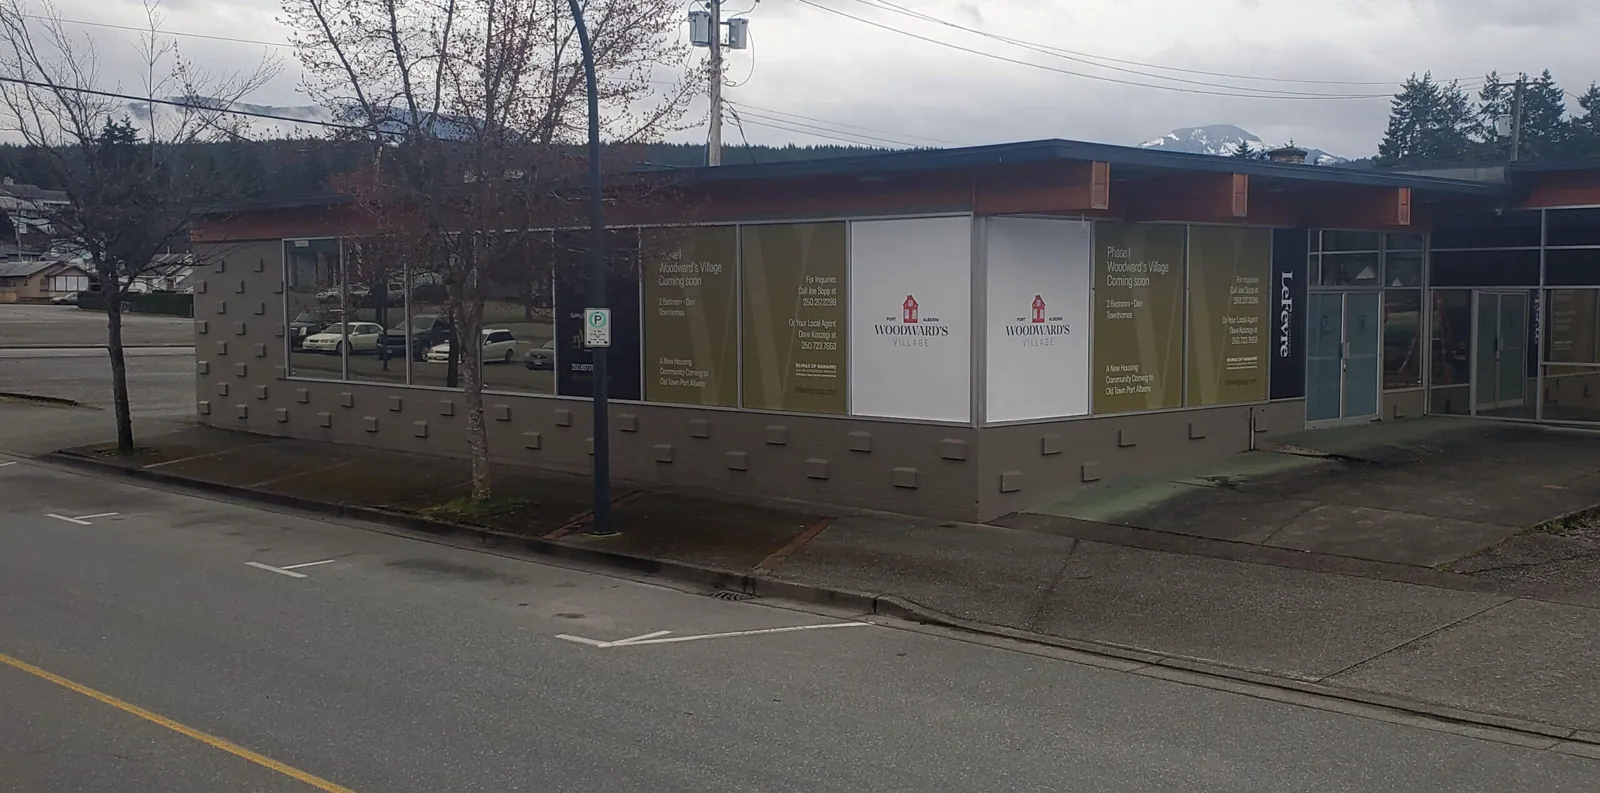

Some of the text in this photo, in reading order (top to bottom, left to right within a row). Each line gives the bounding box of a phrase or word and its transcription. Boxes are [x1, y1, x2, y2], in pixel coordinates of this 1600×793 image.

[1107, 246, 1128, 259] Phase
[658, 261, 722, 275] Woodward's Village
[1107, 260, 1169, 275] Woodward's Village
[658, 275, 702, 288] Coming soon
[806, 276, 837, 285] For Inquiries
[1107, 274, 1150, 288] Coming soon
[798, 286, 808, 295] Call
[808, 287, 817, 295] Joe
[817, 287, 830, 296] Sopp
[1106, 300, 1110, 308] 2
[1110, 300, 1130, 308] Bedroom
[594, 315, 602, 324] P
[1106, 311, 1133, 319] Townhomes
[1280, 271, 1293, 358] LeFevre
[788, 318, 837, 329] Or Your Local Agent
[798, 330, 811, 338] Dave
[874, 325, 949, 337] WOODWARD'S
[1006, 325, 1070, 336] WOODWARD'S
[893, 338, 929, 348] VILLAGE
[1022, 338, 1054, 347] VILLAGE
[664, 357, 673, 365] New
[674, 358, 692, 367] Housing
[660, 368, 685, 376] Community
[685, 368, 702, 378] Coming
[1121, 364, 1138, 372] Housing
[668, 378, 680, 386] Town
[680, 379, 690, 387] Port
[690, 380, 706, 388] Alberni
[1106, 376, 1131, 384] Community
[1132, 374, 1148, 383] Coming
[1114, 387, 1126, 395] Town
